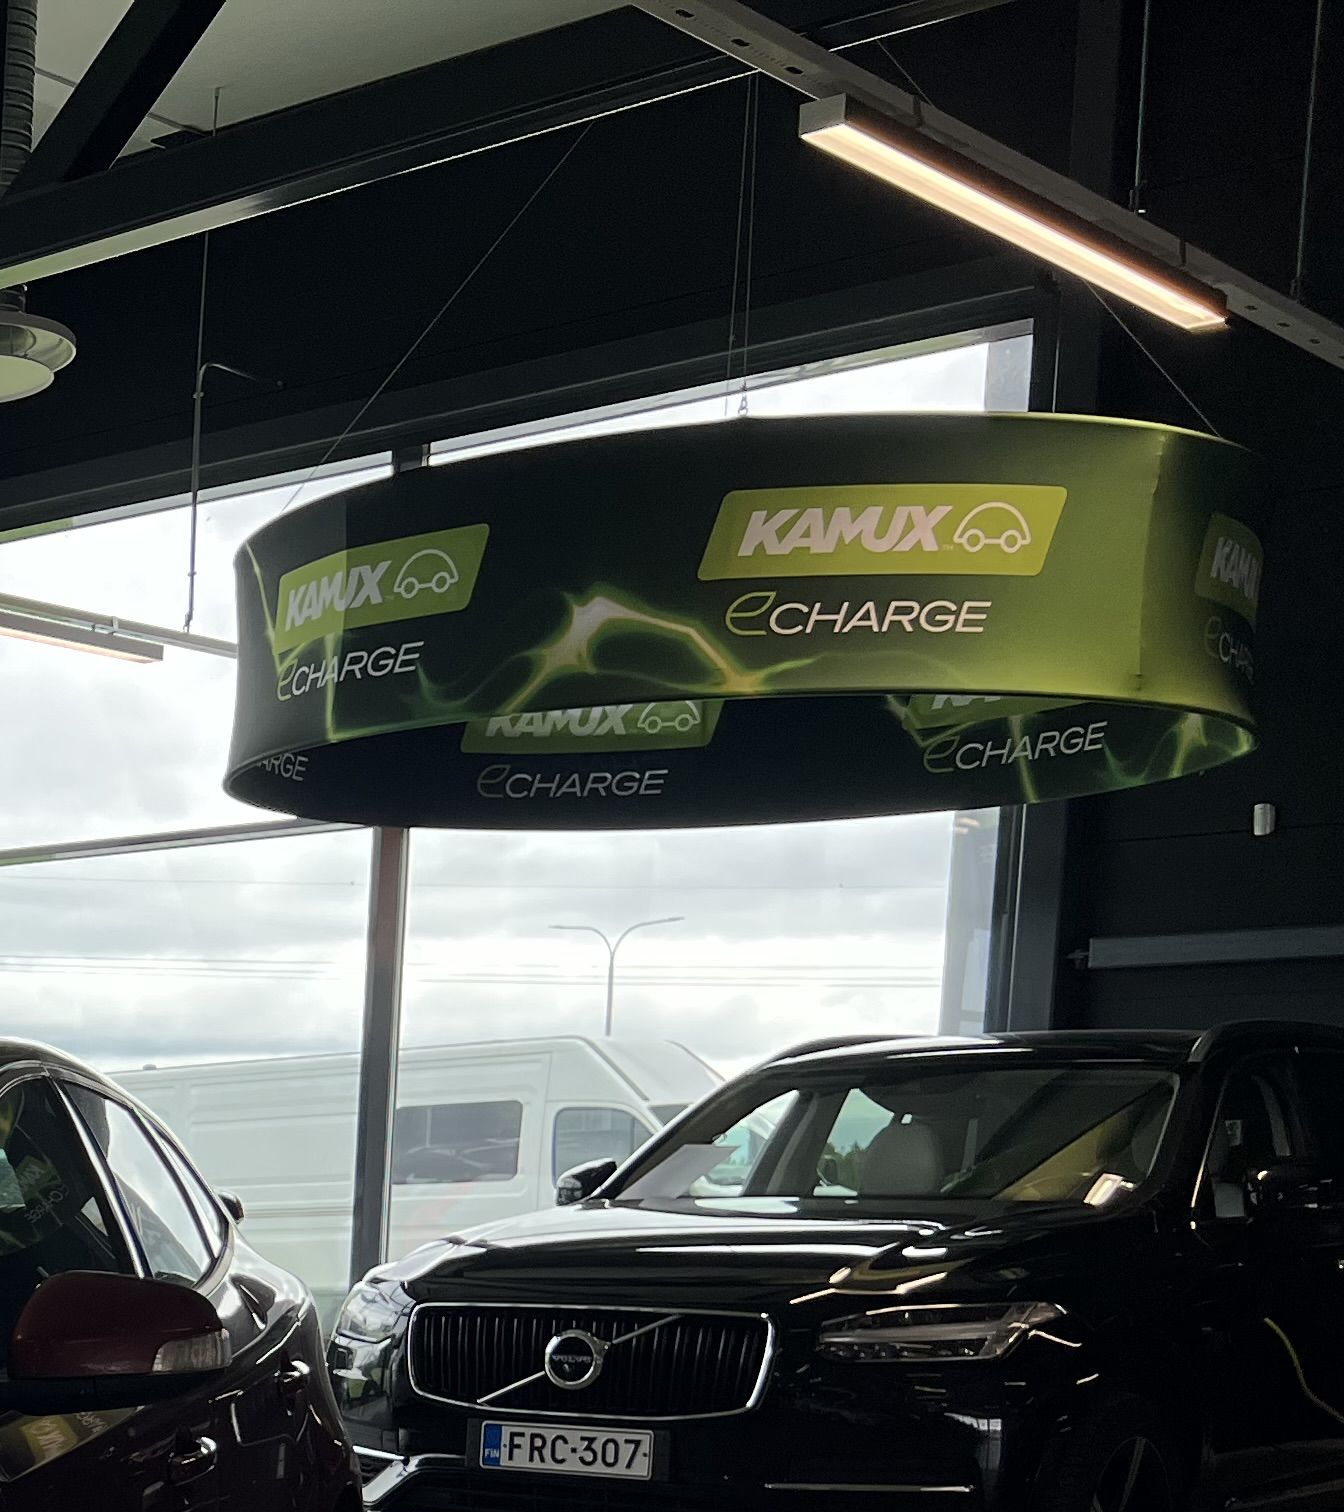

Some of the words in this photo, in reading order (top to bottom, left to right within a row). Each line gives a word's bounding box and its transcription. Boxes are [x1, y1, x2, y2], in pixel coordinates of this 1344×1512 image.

[737, 505, 953, 557] KAMUX
[285, 560, 392, 632] KAMUX
[484, 1448, 500, 1459] FIN
[507, 1431, 642, 1470] FRC-307
